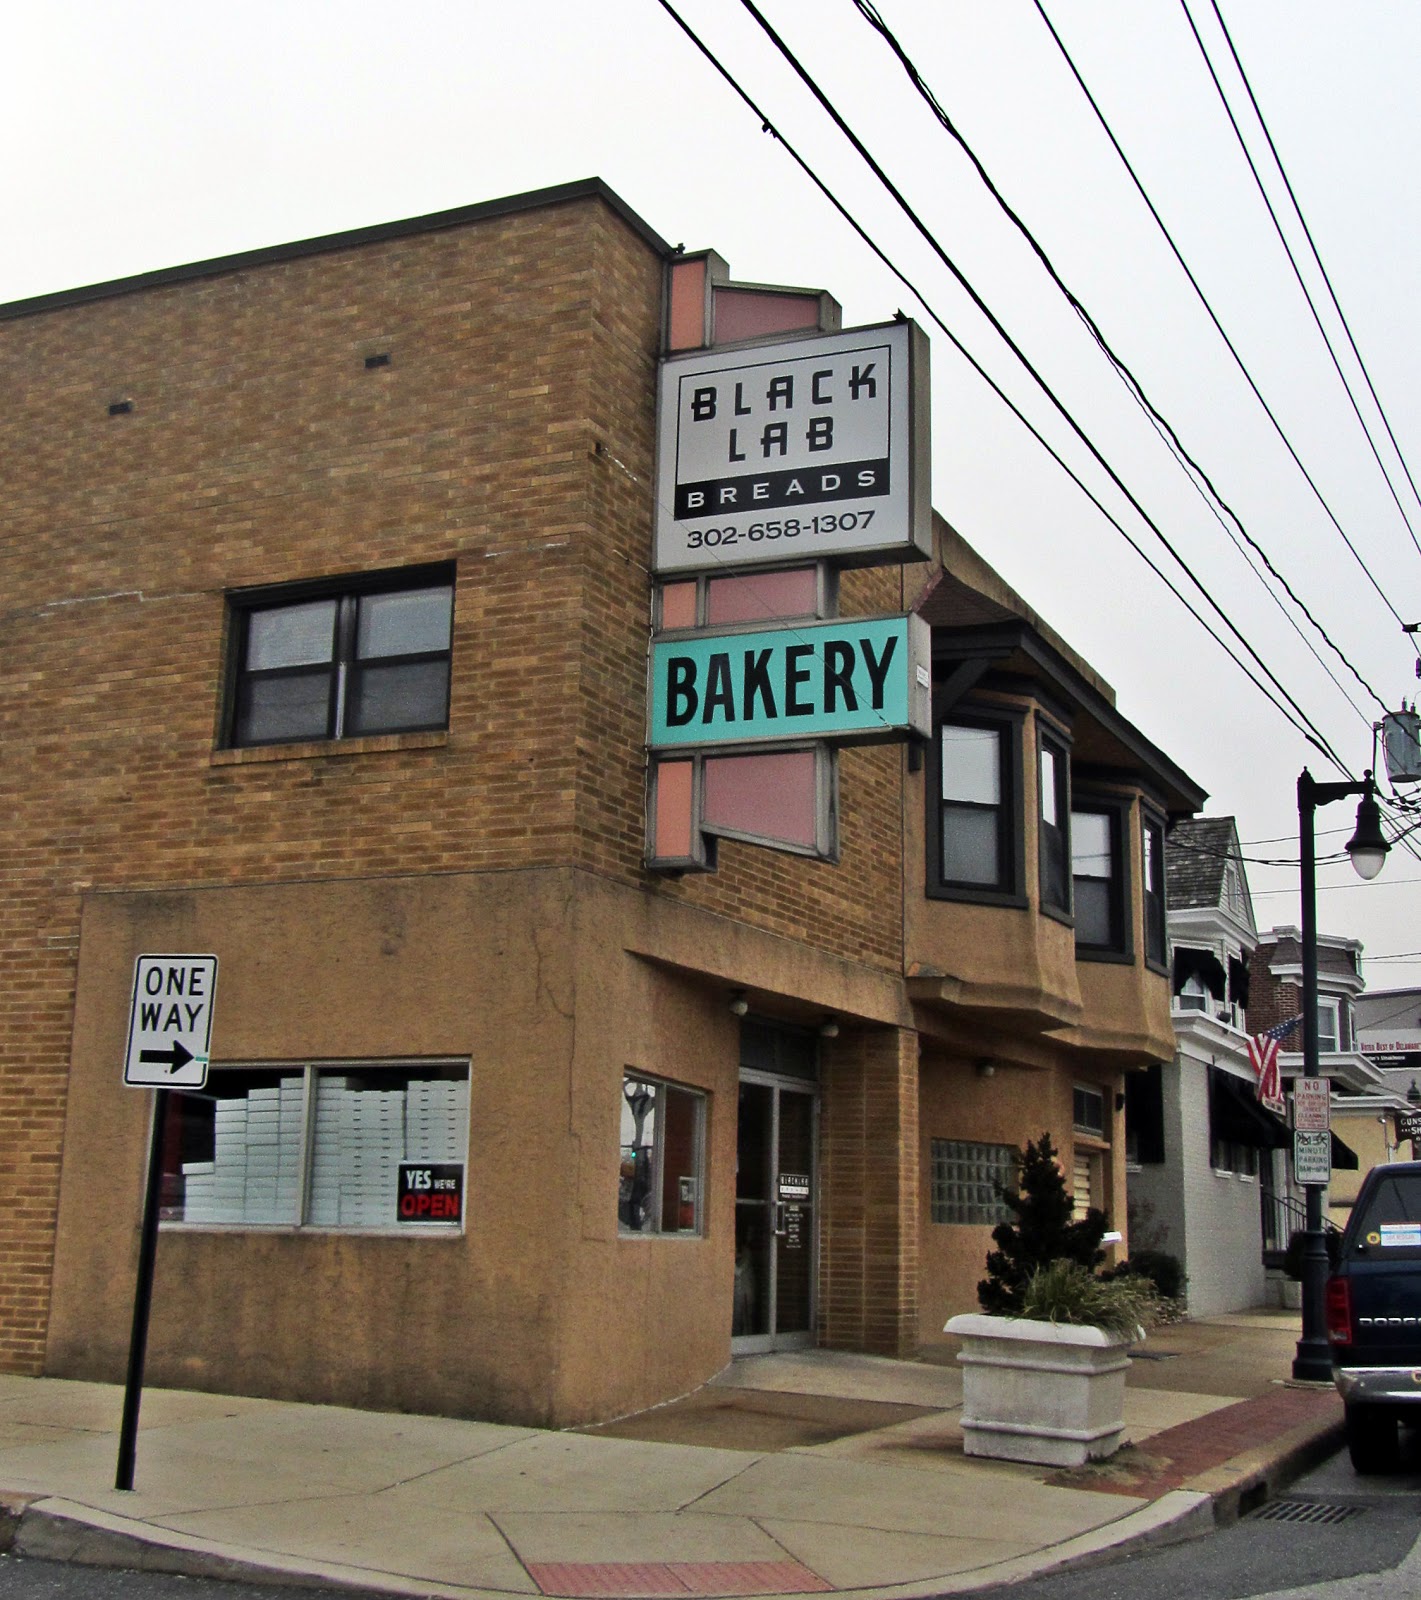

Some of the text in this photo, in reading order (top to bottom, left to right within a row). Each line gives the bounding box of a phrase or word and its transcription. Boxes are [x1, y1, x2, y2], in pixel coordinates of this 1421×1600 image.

[691, 363, 876, 422] BLACK
[728, 415, 833, 462] LAB
[687, 470, 876, 509] BREADS
[686, 510, 876, 548] 302-658-1307
[666, 635, 899, 727] BAKERY
[145, 966, 205, 996] ONE
[141, 1003, 204, 1032] WAY
[1297, 1092, 1326, 1100] PARKING
[1304, 1080, 1319, 1091] NO
[1298, 1156, 1328, 1164] PARKING
[406, 1170, 456, 1190] YES WE'RE
[401, 1194, 459, 1217] OPEN
